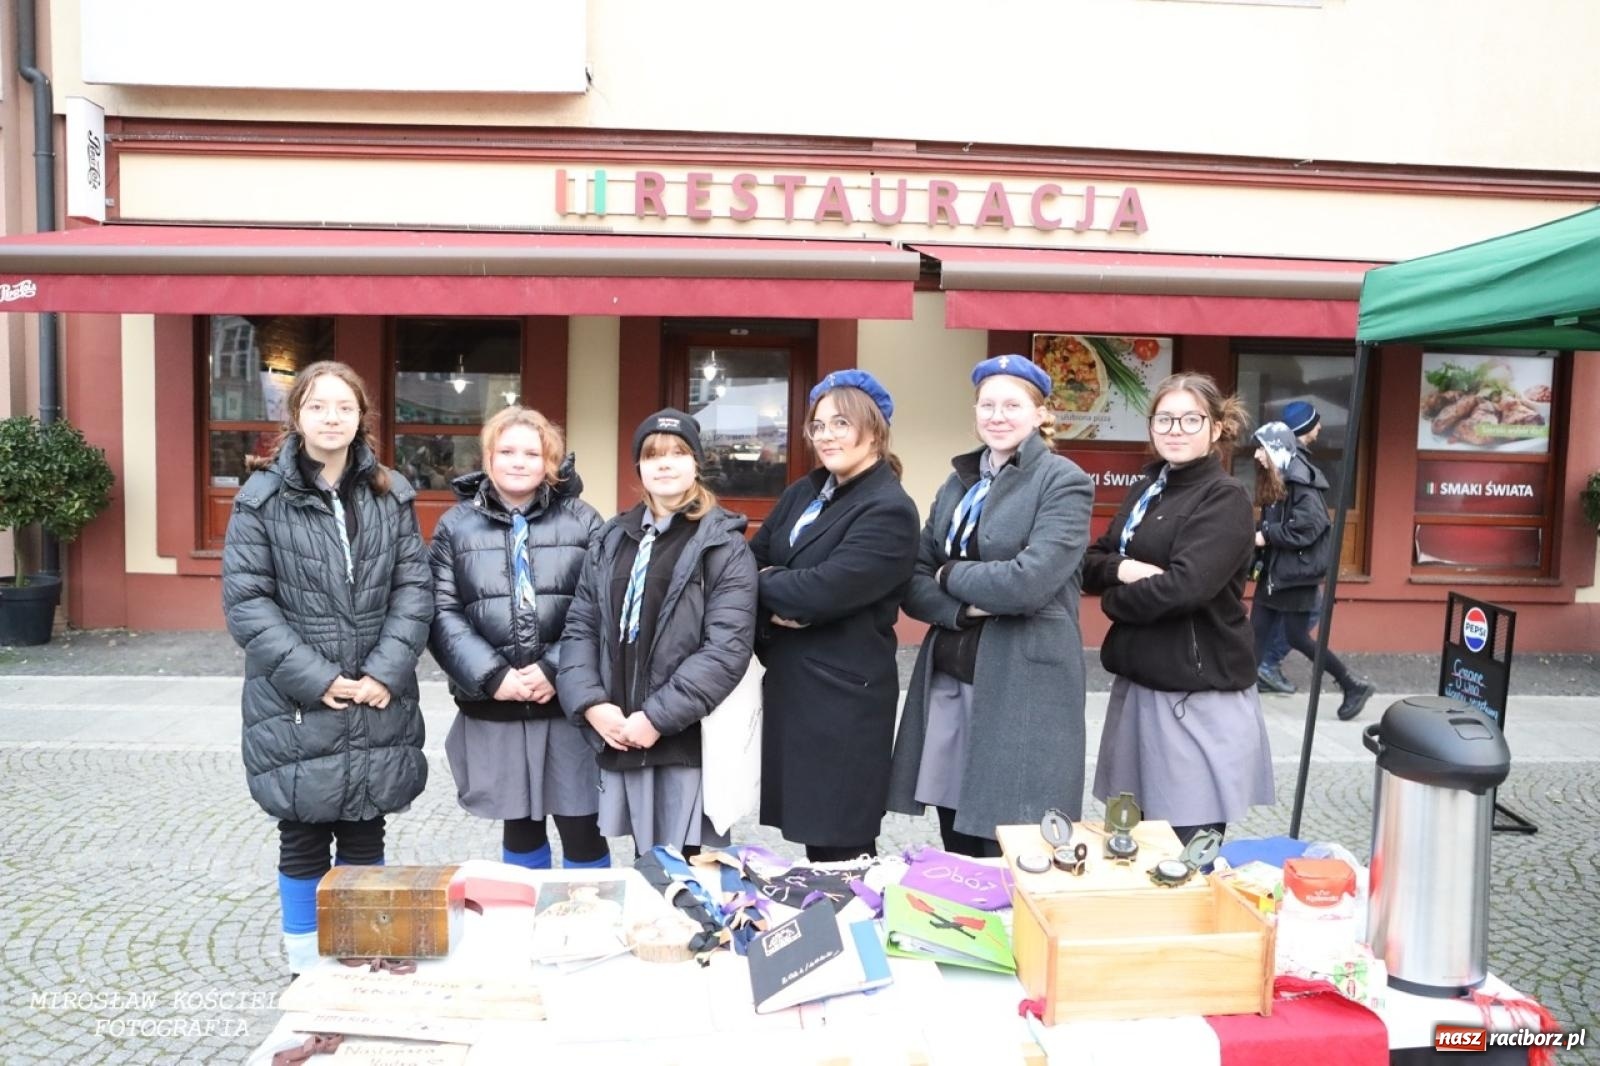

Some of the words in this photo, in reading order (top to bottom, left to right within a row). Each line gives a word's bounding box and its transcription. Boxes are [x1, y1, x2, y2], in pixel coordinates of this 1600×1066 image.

[634, 170, 1148, 234] RESTAURACJA
[1103, 470, 1146, 486] ŚWIAT
[1440, 483, 1482, 495] SMAKI
[1485, 480, 1534, 497] ŚWIATA
[1465, 622, 1487, 637] PEPSI
